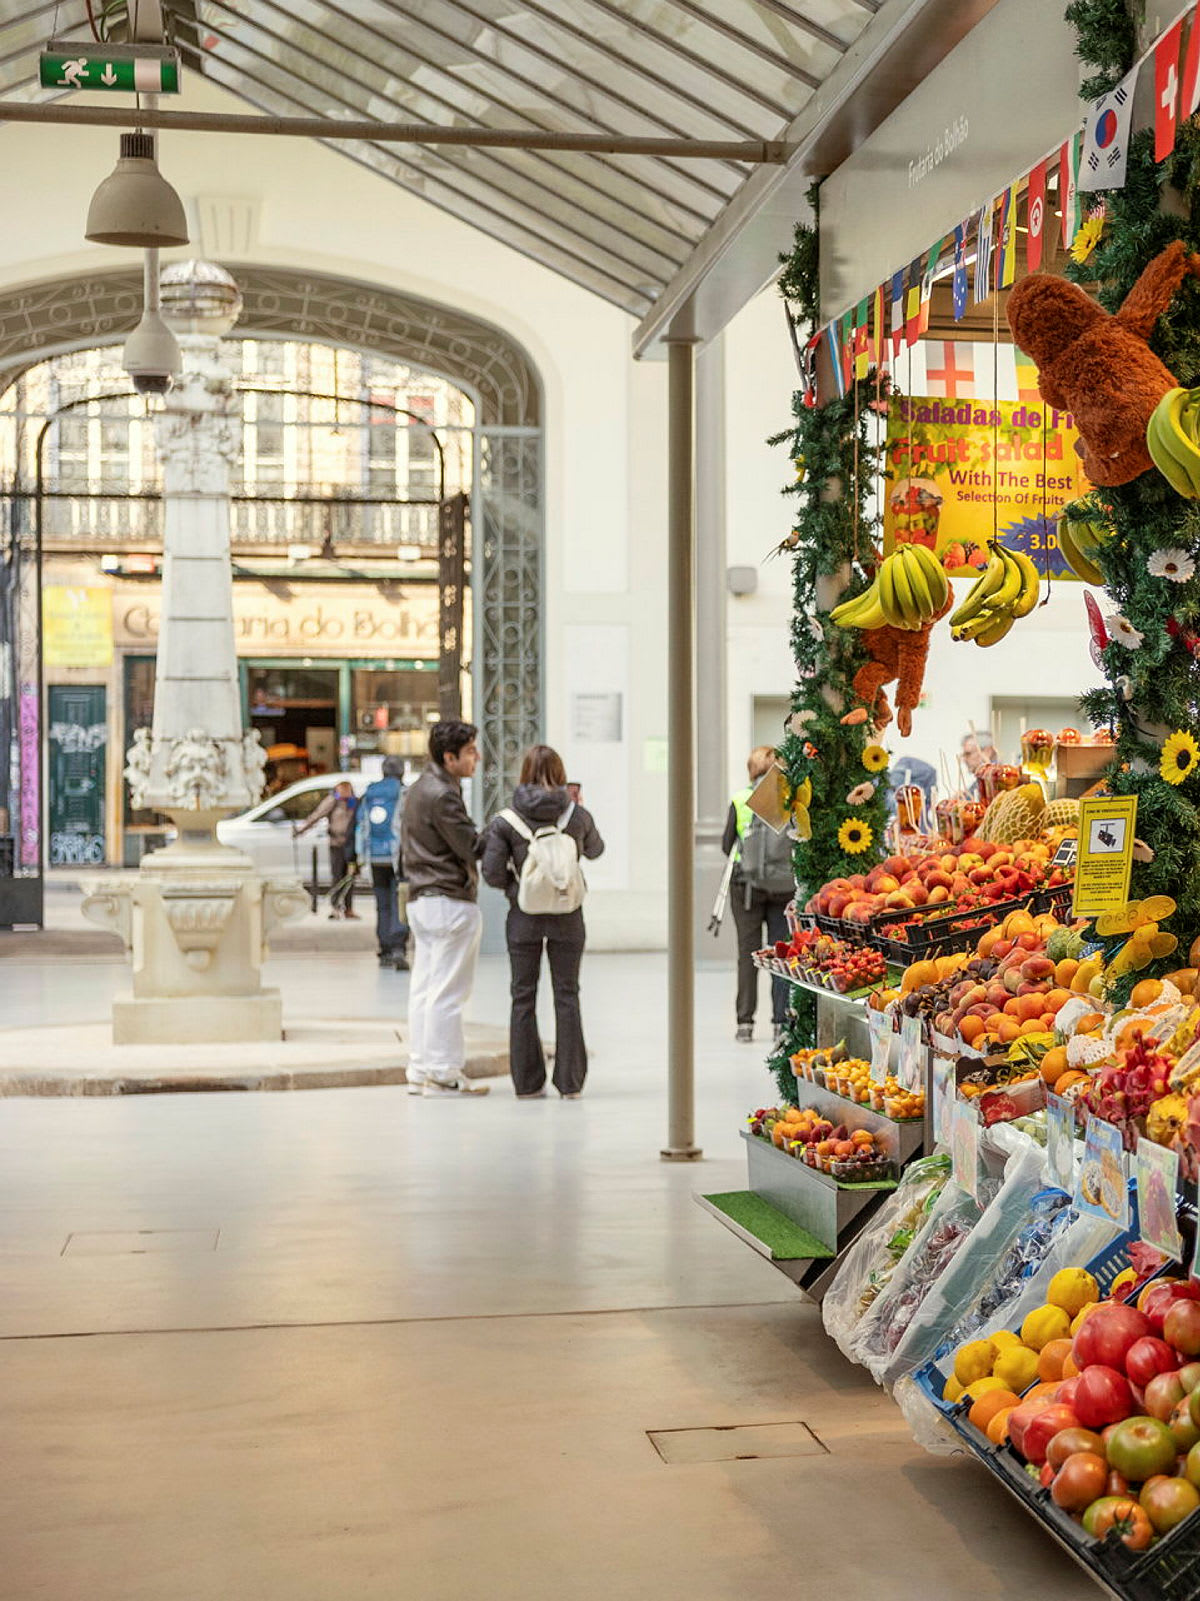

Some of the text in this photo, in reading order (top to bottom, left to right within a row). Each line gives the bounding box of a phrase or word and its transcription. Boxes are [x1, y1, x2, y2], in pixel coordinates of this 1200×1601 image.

[900, 401, 1002, 427] Saladas
[1012, 406, 1041, 428] de
[892, 433, 1063, 464] Fruit salad
[949, 470, 1072, 490] With The Best
[957, 490, 1065, 506] Selection Of Fruits
[1030, 534, 1060, 550] 3.0
[299, 605, 344, 638] do
